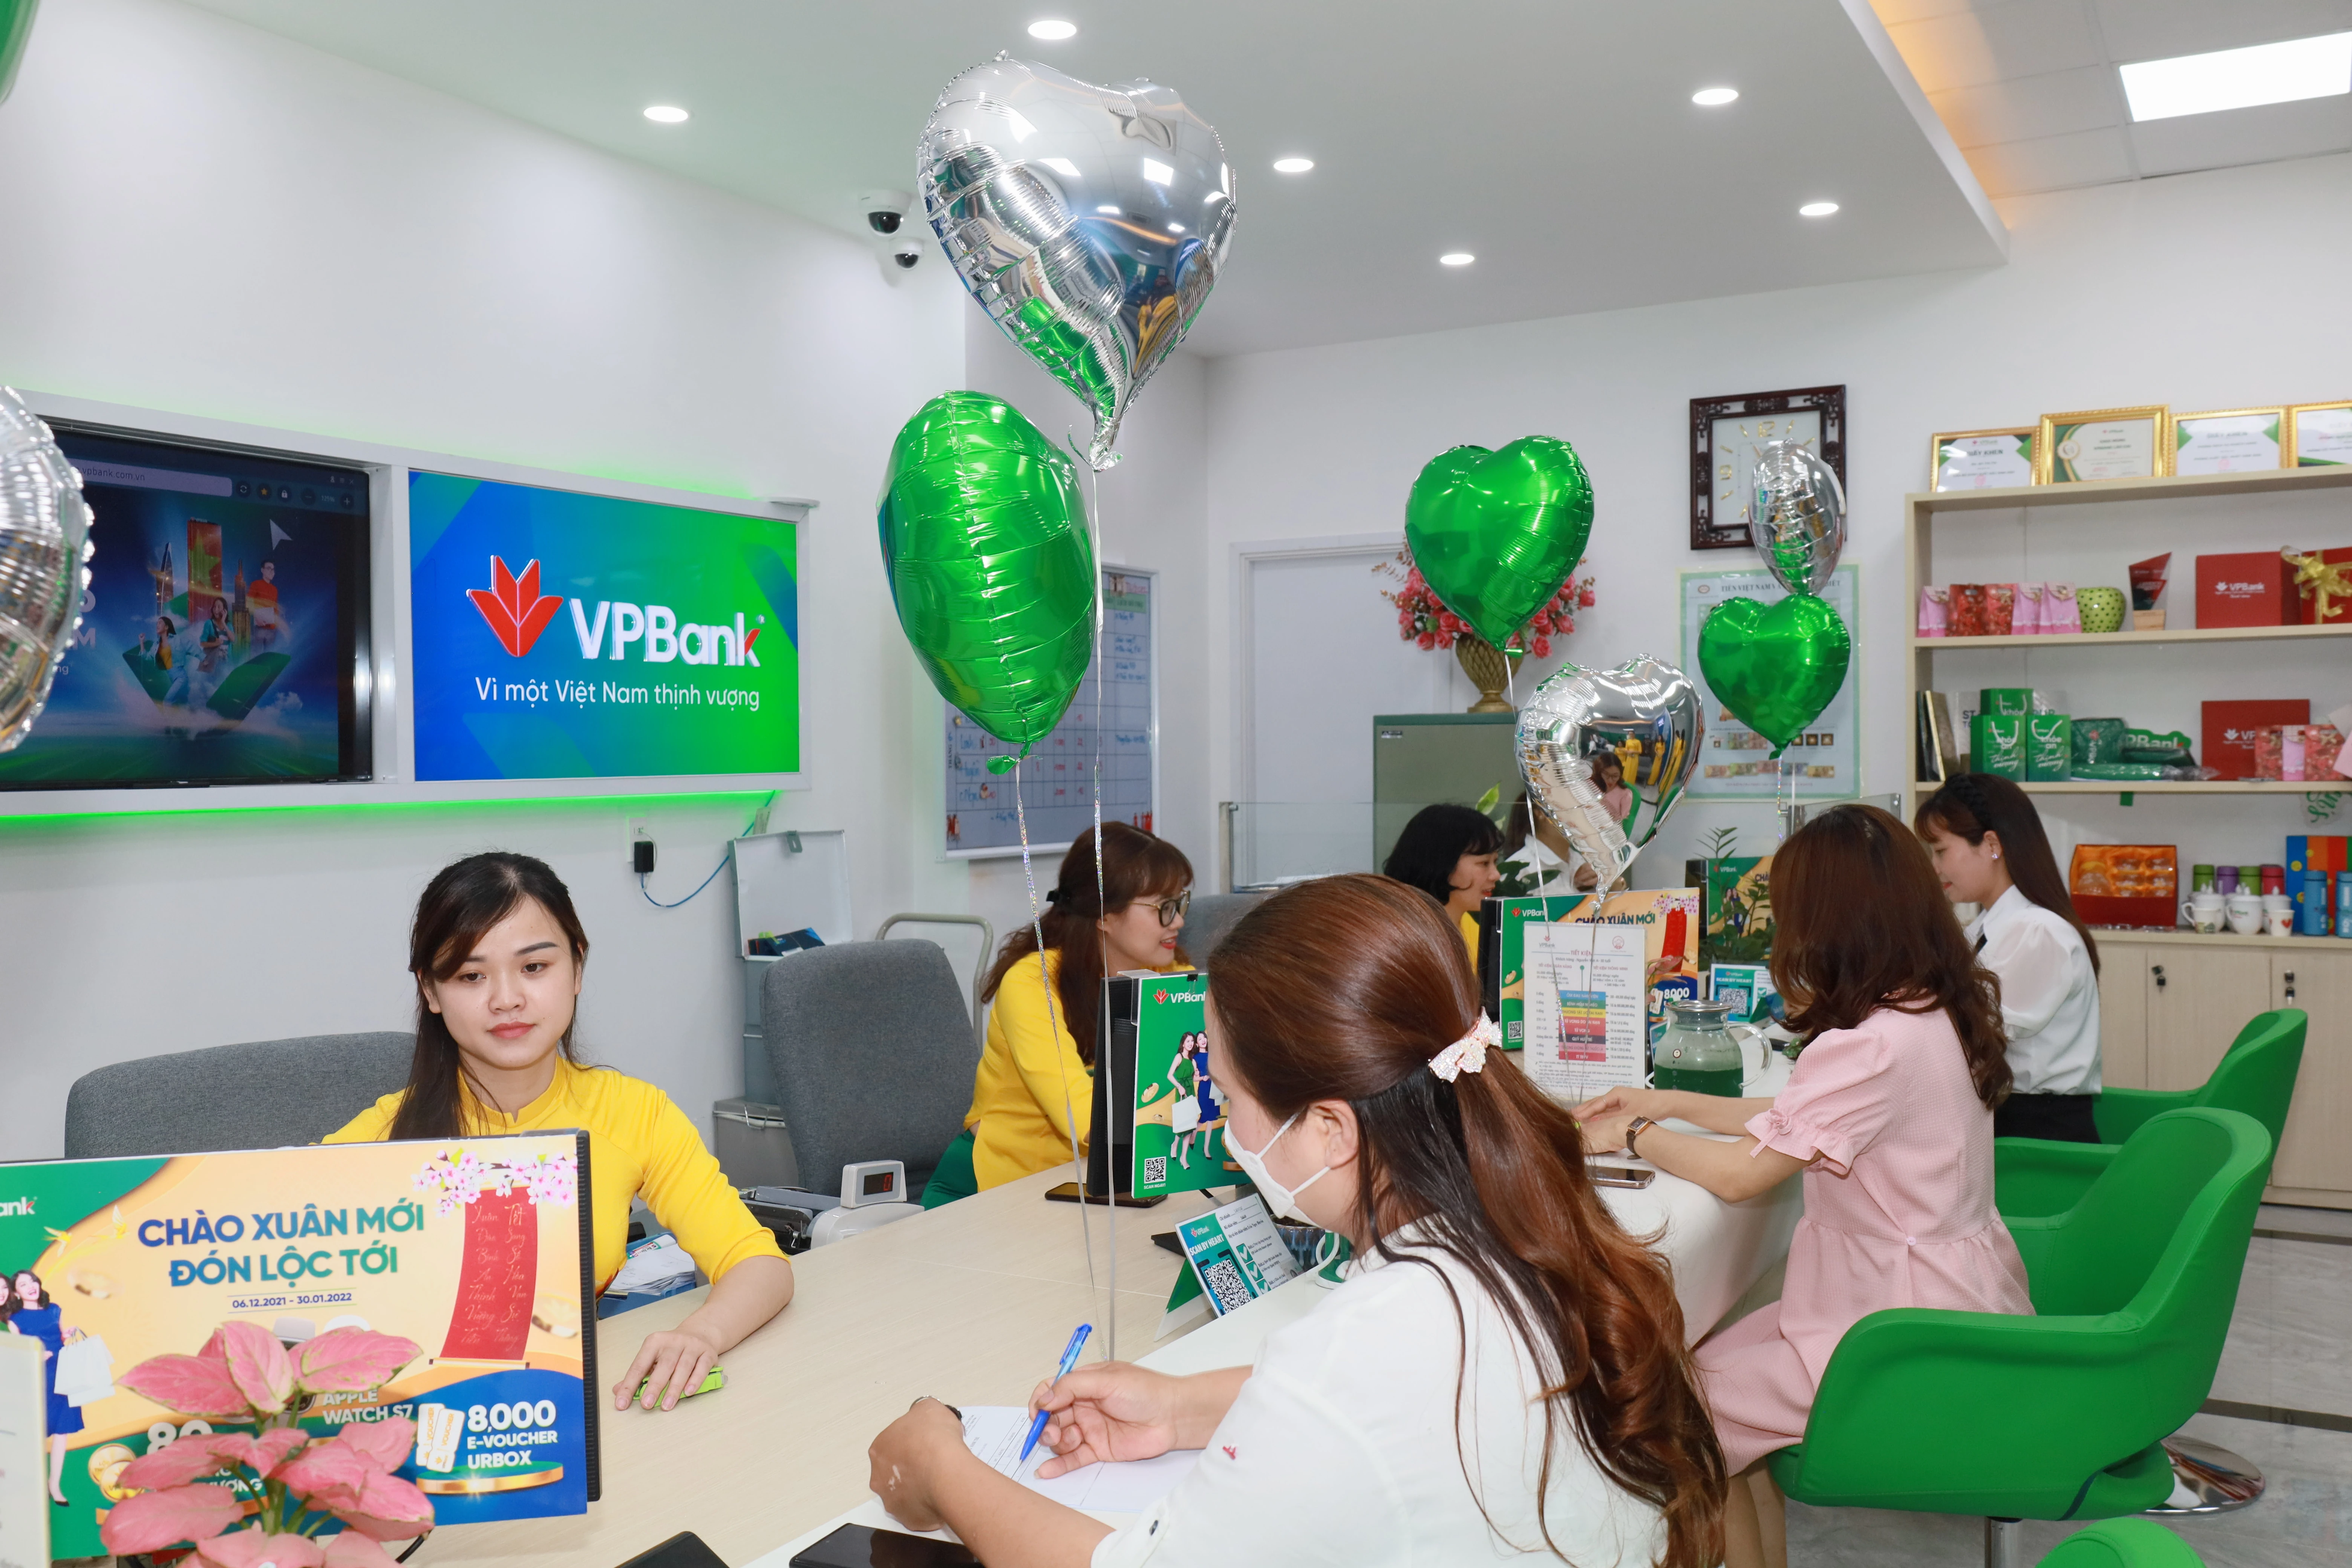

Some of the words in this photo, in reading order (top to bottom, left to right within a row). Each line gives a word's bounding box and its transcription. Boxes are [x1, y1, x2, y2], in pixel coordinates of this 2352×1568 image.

[569, 598, 761, 667] VPBank
[475, 677, 498, 701] Vì
[505, 680, 548, 709] một
[555, 680, 596, 709] Việt
[603, 681, 648, 705] Nam
[654, 684, 700, 711] thịnh
[706, 687, 760, 712] vượng
[1607, 912, 1634, 925] XUÂN
[1636, 911, 1655, 925] MỚI
[884, 1174, 892, 1192] 0
[138, 1210, 244, 1247] CHÀO
[252, 1204, 347, 1240] XUÂN
[356, 1197, 424, 1235] MỚI
[1196, 1225, 1210, 1236] VPBank
[1189, 1244, 1204, 1256] SCAN
[1200, 1240, 1209, 1251] BY
[1207, 1234, 1224, 1247] HEART
[169, 1250, 251, 1287] ĐÓN
[260, 1245, 333, 1288] LỘC
[339, 1240, 398, 1276] TỚI
[232, 1297, 286, 1309] 06.12.2021
[297, 1292, 352, 1305] 30.01.2022
[323, 1389, 378, 1407] APPLE
[322, 1406, 388, 1425] WATCH
[392, 1404, 413, 1419] S7
[467, 1400, 556, 1432] 8,000
[441, 1413, 454, 1446] VOUCHER
[467, 1430, 558, 1450] E-VOUCHER
[467, 1450, 532, 1470] URBOX
